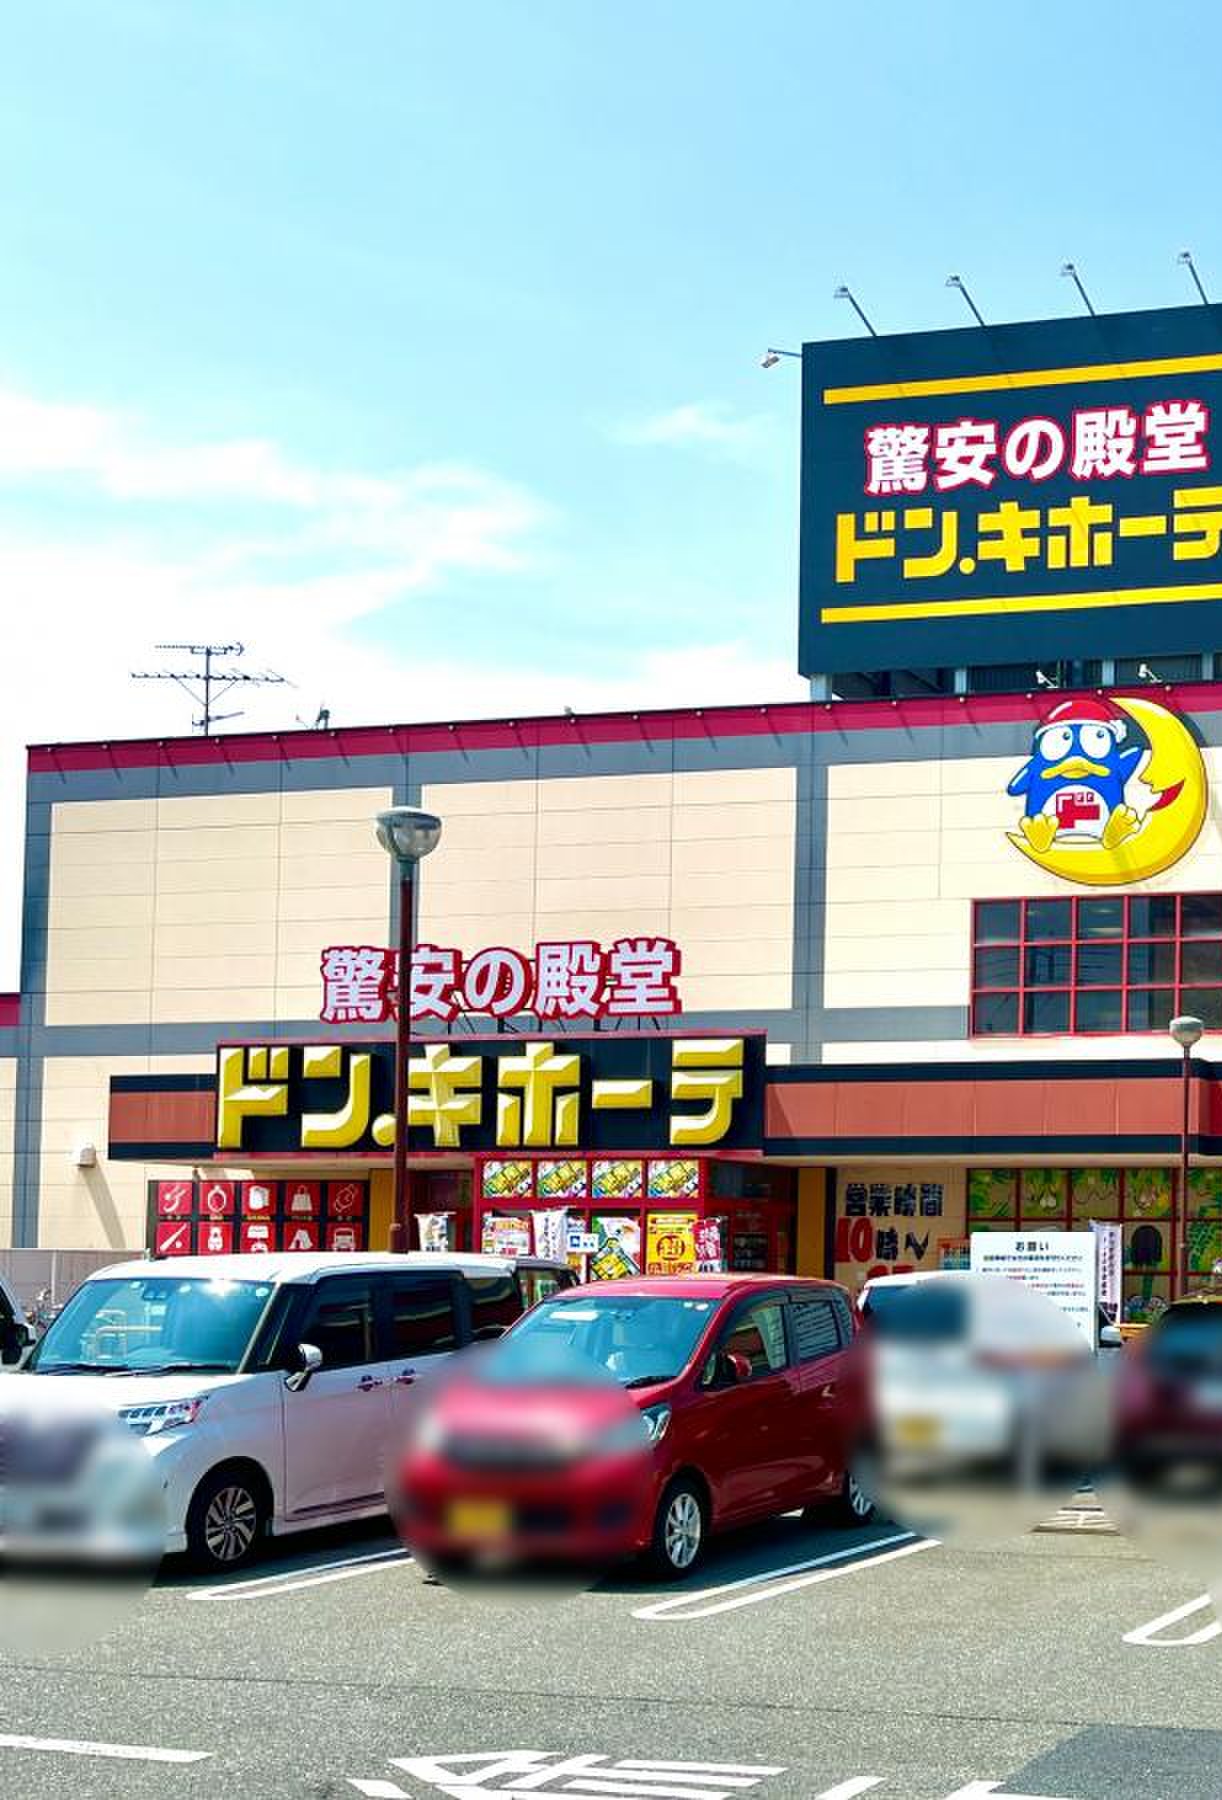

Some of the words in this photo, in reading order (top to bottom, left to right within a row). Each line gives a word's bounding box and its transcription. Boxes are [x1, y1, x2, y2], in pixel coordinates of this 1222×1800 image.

[865, 401, 1209, 494] 驚安の殿堂
[321, 938, 683, 1023] 驚安の殿堂
